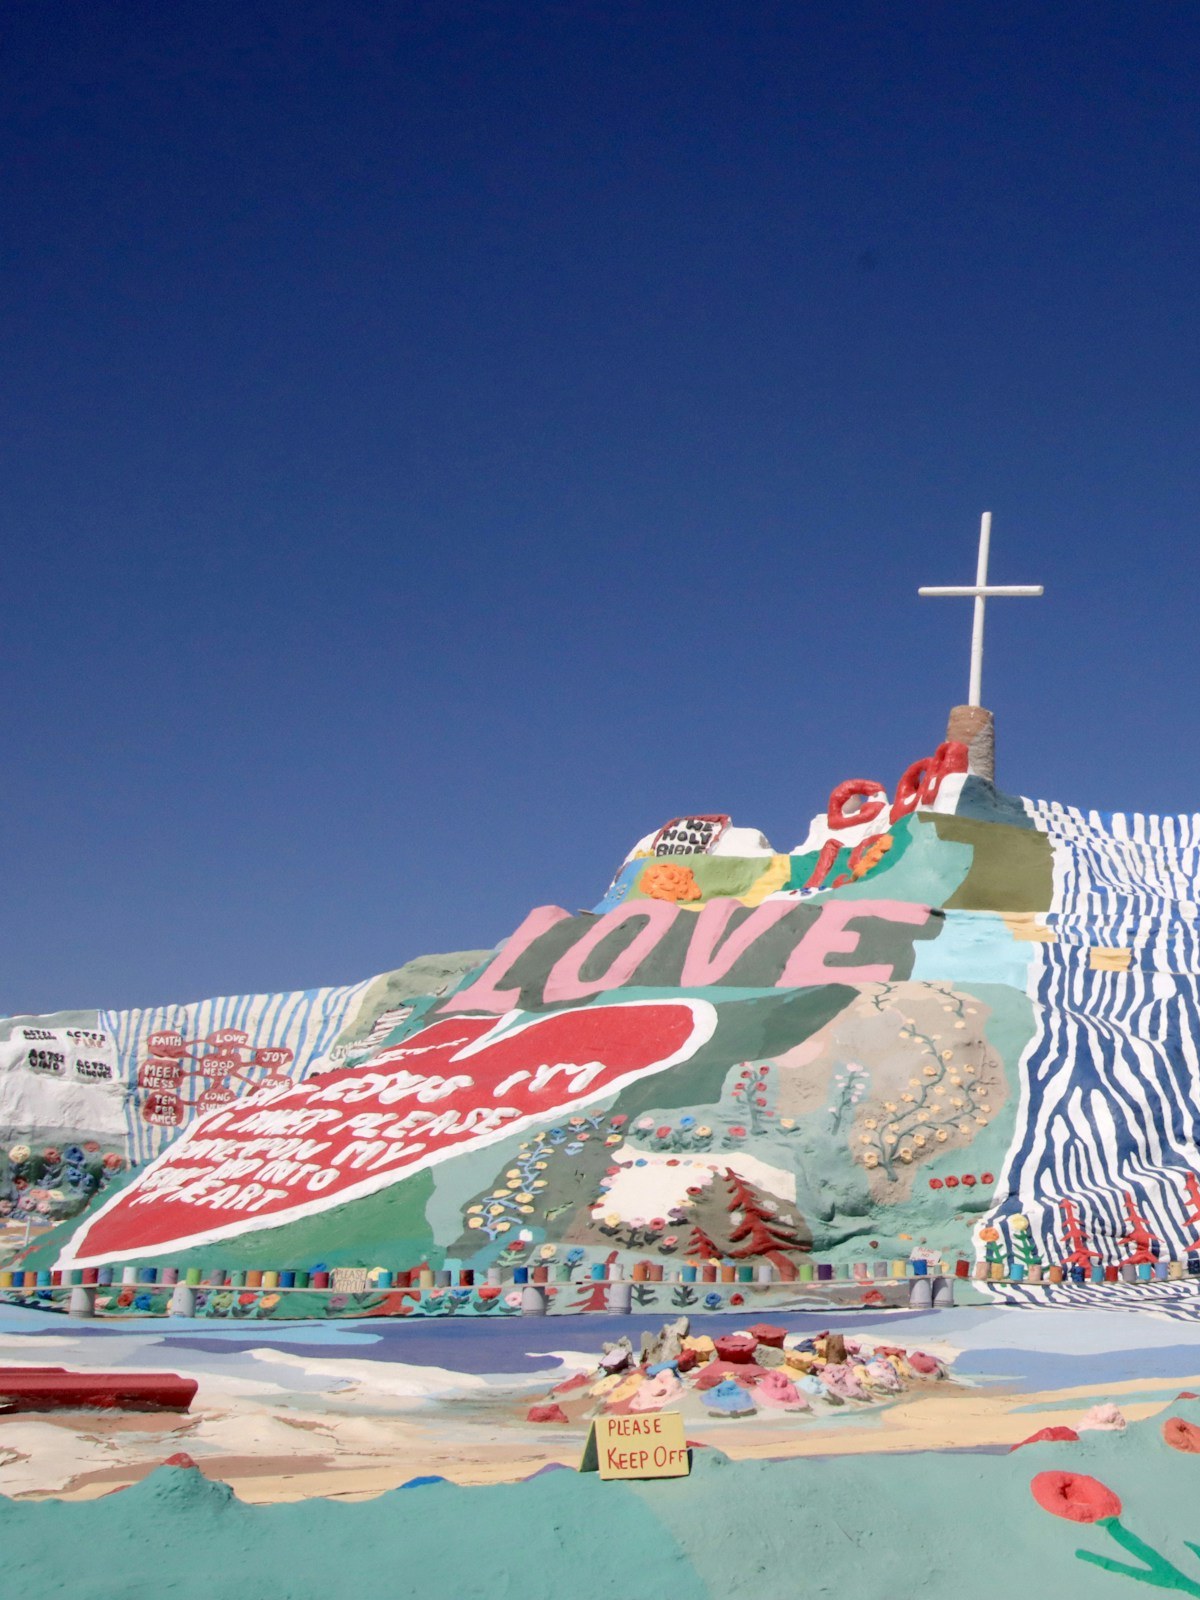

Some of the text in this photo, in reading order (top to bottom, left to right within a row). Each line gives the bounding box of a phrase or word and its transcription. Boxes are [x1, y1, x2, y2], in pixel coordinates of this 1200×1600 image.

[828, 741, 969, 830] GOD
[662, 829, 713, 845] HOLY
[436, 898, 929, 1014] LOVE
[151, 1035, 183, 1047] FAITH
[215, 1034, 248, 1045] LOVE
[202, 1058, 235, 1068] GOOD
[261, 1051, 289, 1065] JOY
[143, 1064, 181, 1079] MEEK
[202, 1067, 230, 1077] NESS
[142, 1078, 175, 1089] NESS
[154, 1094, 177, 1105] TEM
[204, 1092, 232, 1102] LONG
[326, 1106, 523, 1138] PLEASE
[330, 1140, 427, 1172] MY
[252, 1160, 340, 1192] INTO
[163, 1179, 289, 1212] HEART
[608, 1418, 662, 1437] PLEASE
[607, 1445, 687, 1470] KEEP OFF
